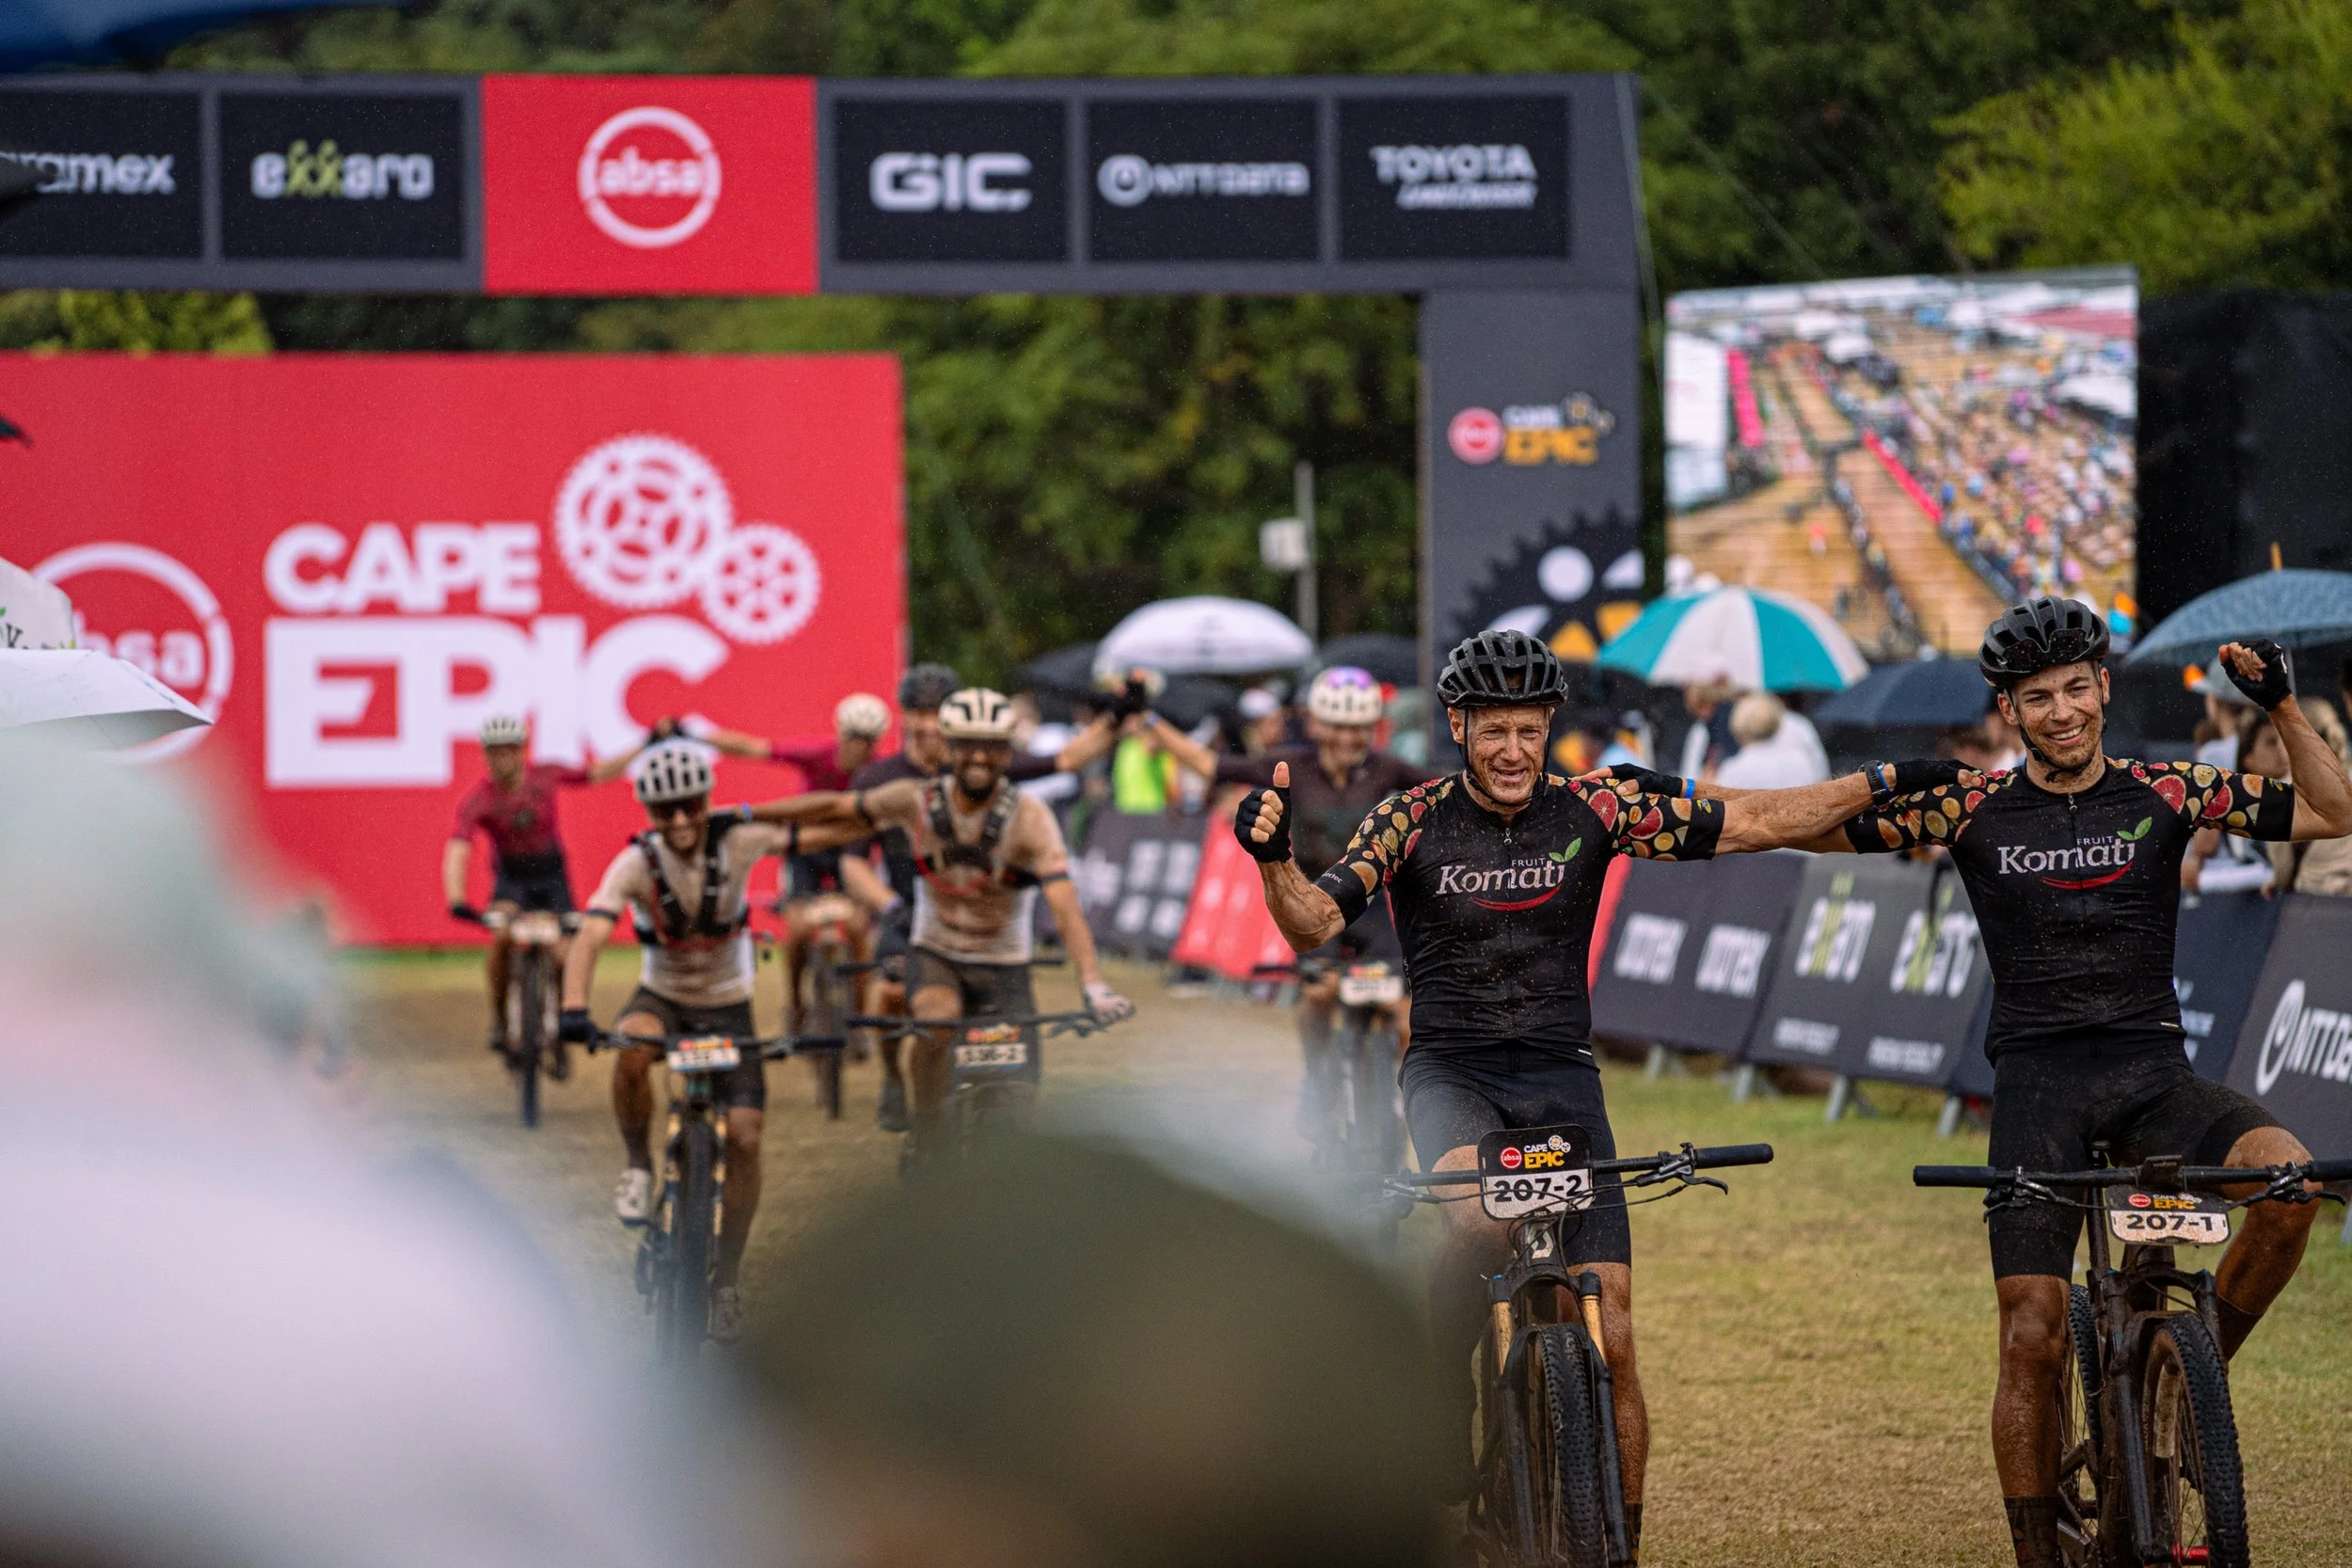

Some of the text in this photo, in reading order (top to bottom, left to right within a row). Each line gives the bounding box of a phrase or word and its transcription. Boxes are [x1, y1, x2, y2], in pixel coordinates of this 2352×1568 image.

[599, 146, 702, 198] absa
[1370, 145, 1538, 183] TOYOTA
[869, 152, 1033, 212] GIC
[263, 523, 541, 614] CAPE
[264, 616, 729, 788] EPIC
[2077, 835, 2114, 846] FRUIT
[1511, 858, 1546, 867] FRUIT
[1997, 838, 2136, 875] Komati
[1436, 860, 1565, 895] Komati
[1524, 1144, 1548, 1153] CAPE
[1524, 1150, 1565, 1169] EPIC
[1494, 1175, 1584, 1203] 207-2
[2153, 1198, 2196, 1210] EPIC
[2126, 1214, 2213, 1231] 207-1
